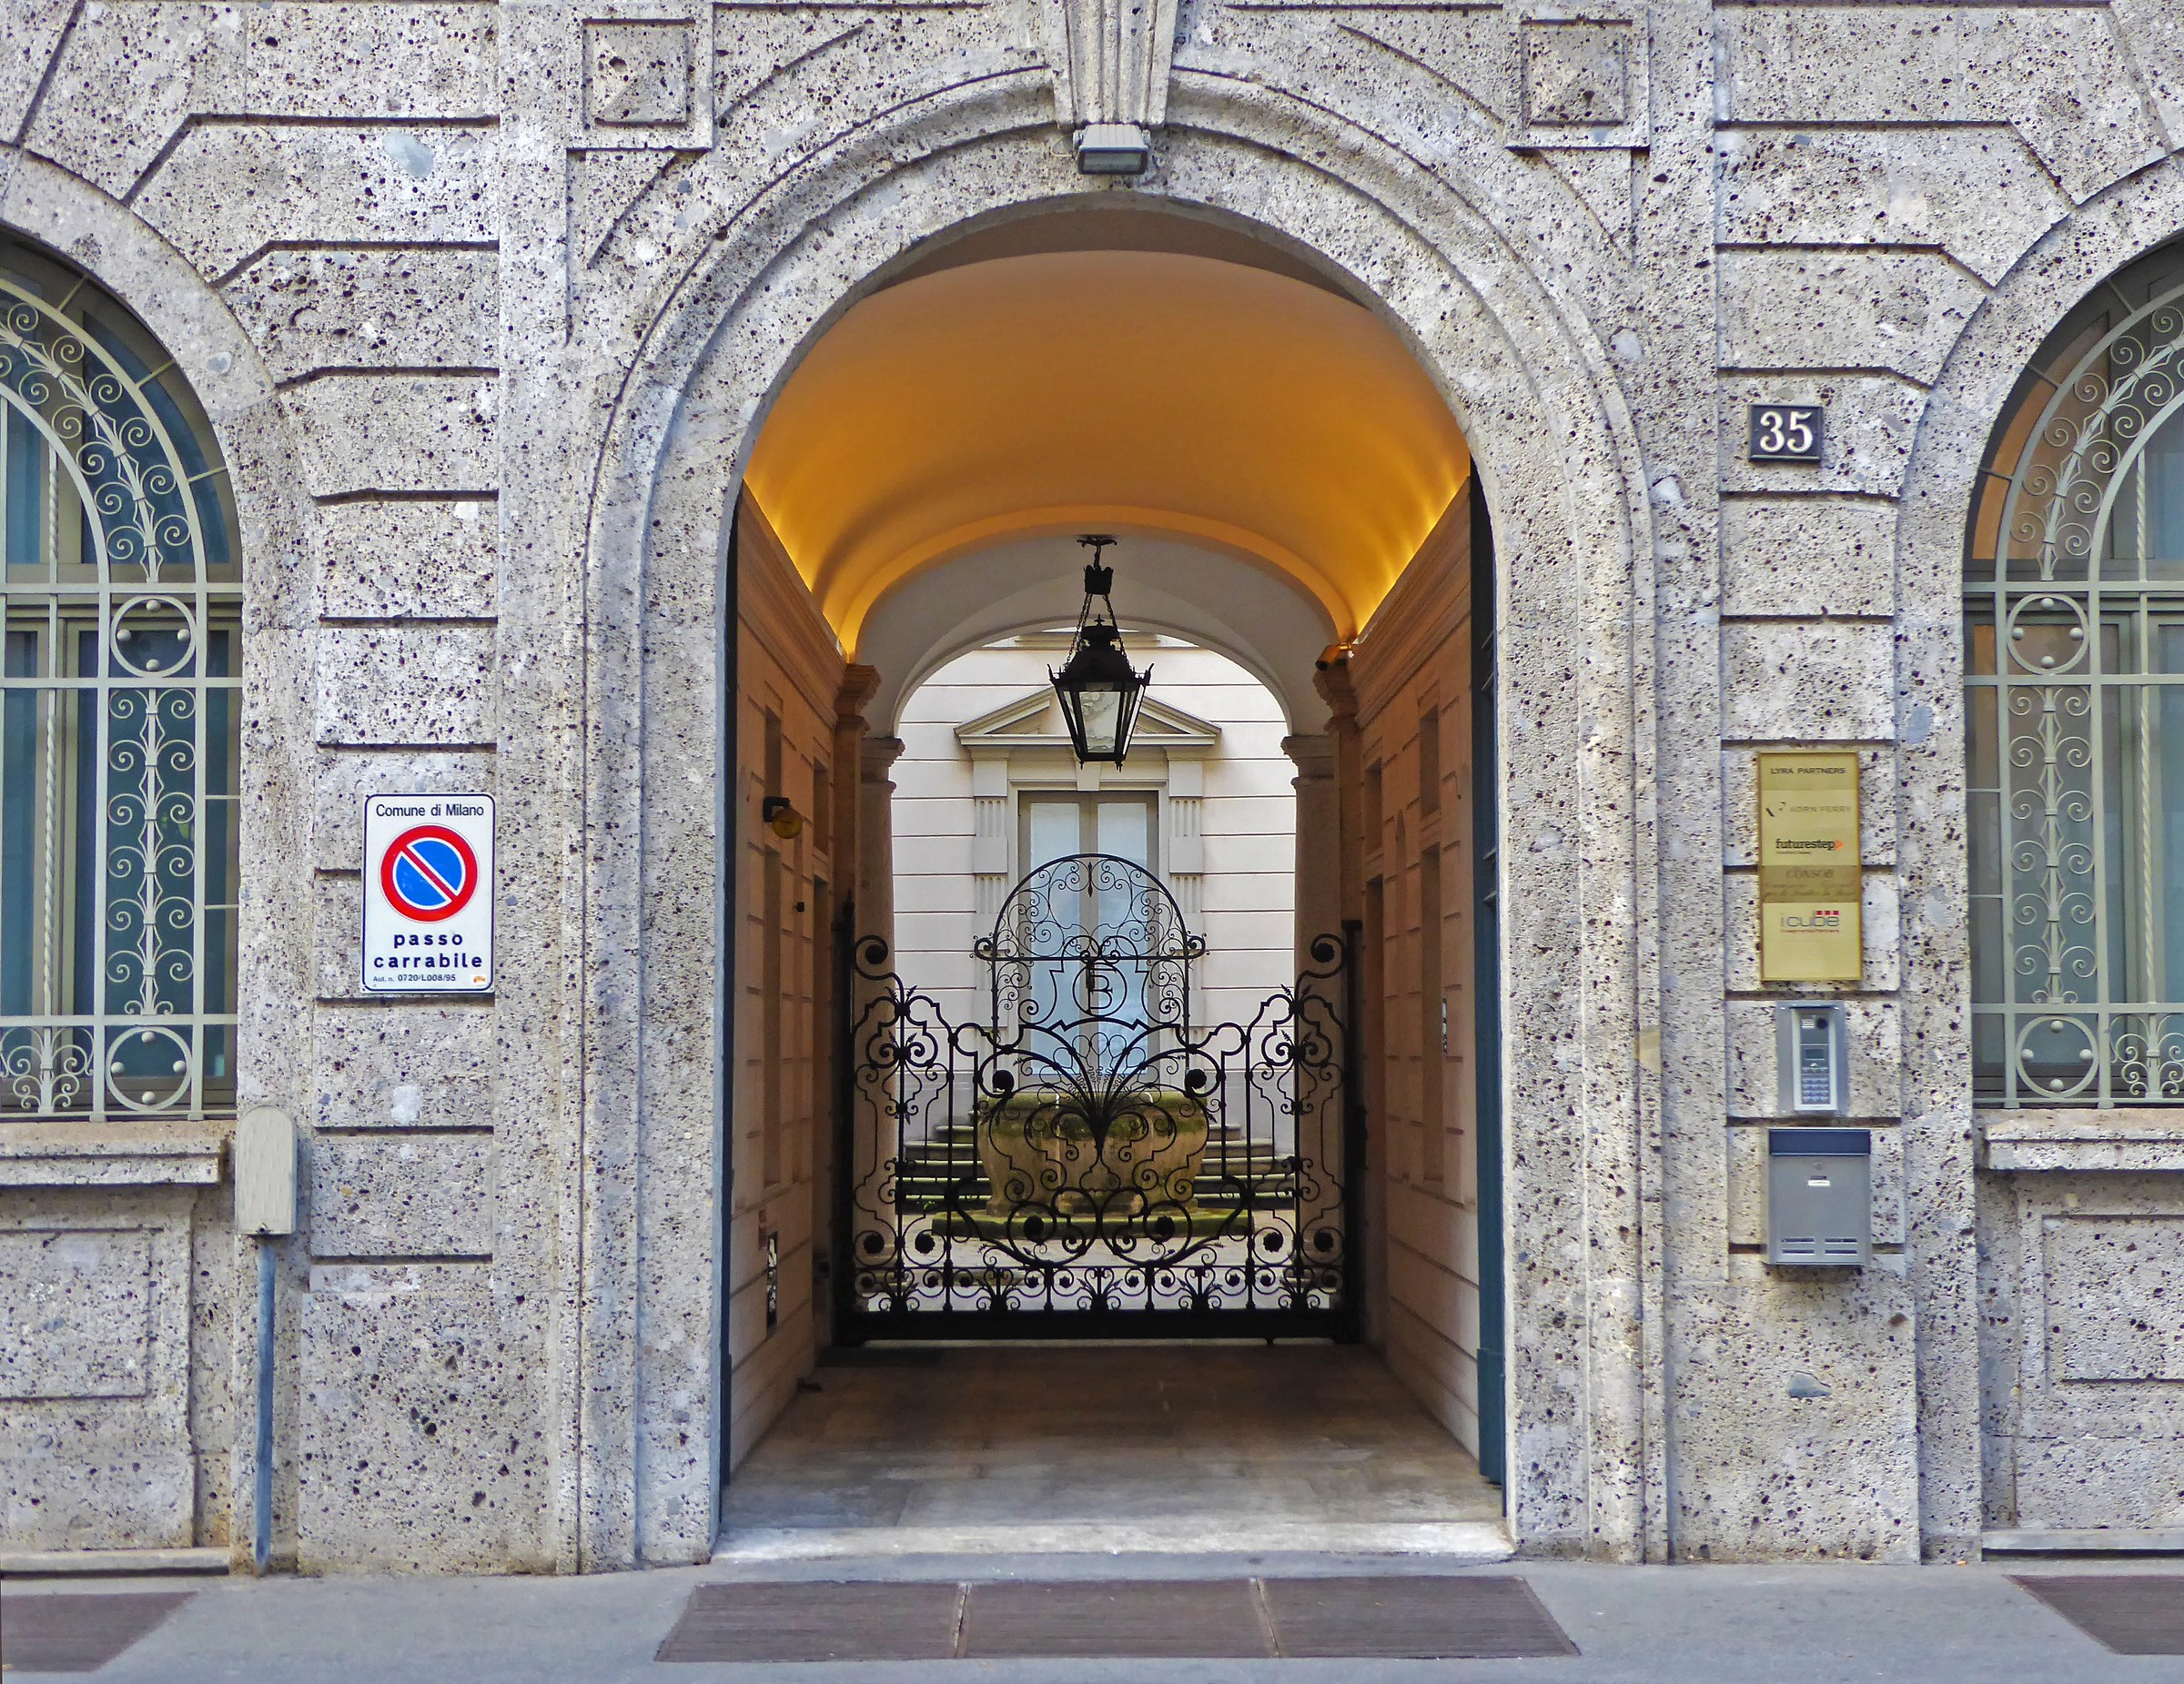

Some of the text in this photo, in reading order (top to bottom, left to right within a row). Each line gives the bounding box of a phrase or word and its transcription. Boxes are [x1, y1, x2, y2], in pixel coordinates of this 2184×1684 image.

[1760, 411, 1813, 452] 35
[376, 803, 484, 817] Comune di Milano
[1775, 838, 1835, 851] futurestep
[393, 933, 463, 949] passo
[373, 953, 482, 968] carrabile
[398, 973, 456, 982] 0720/L008/95
